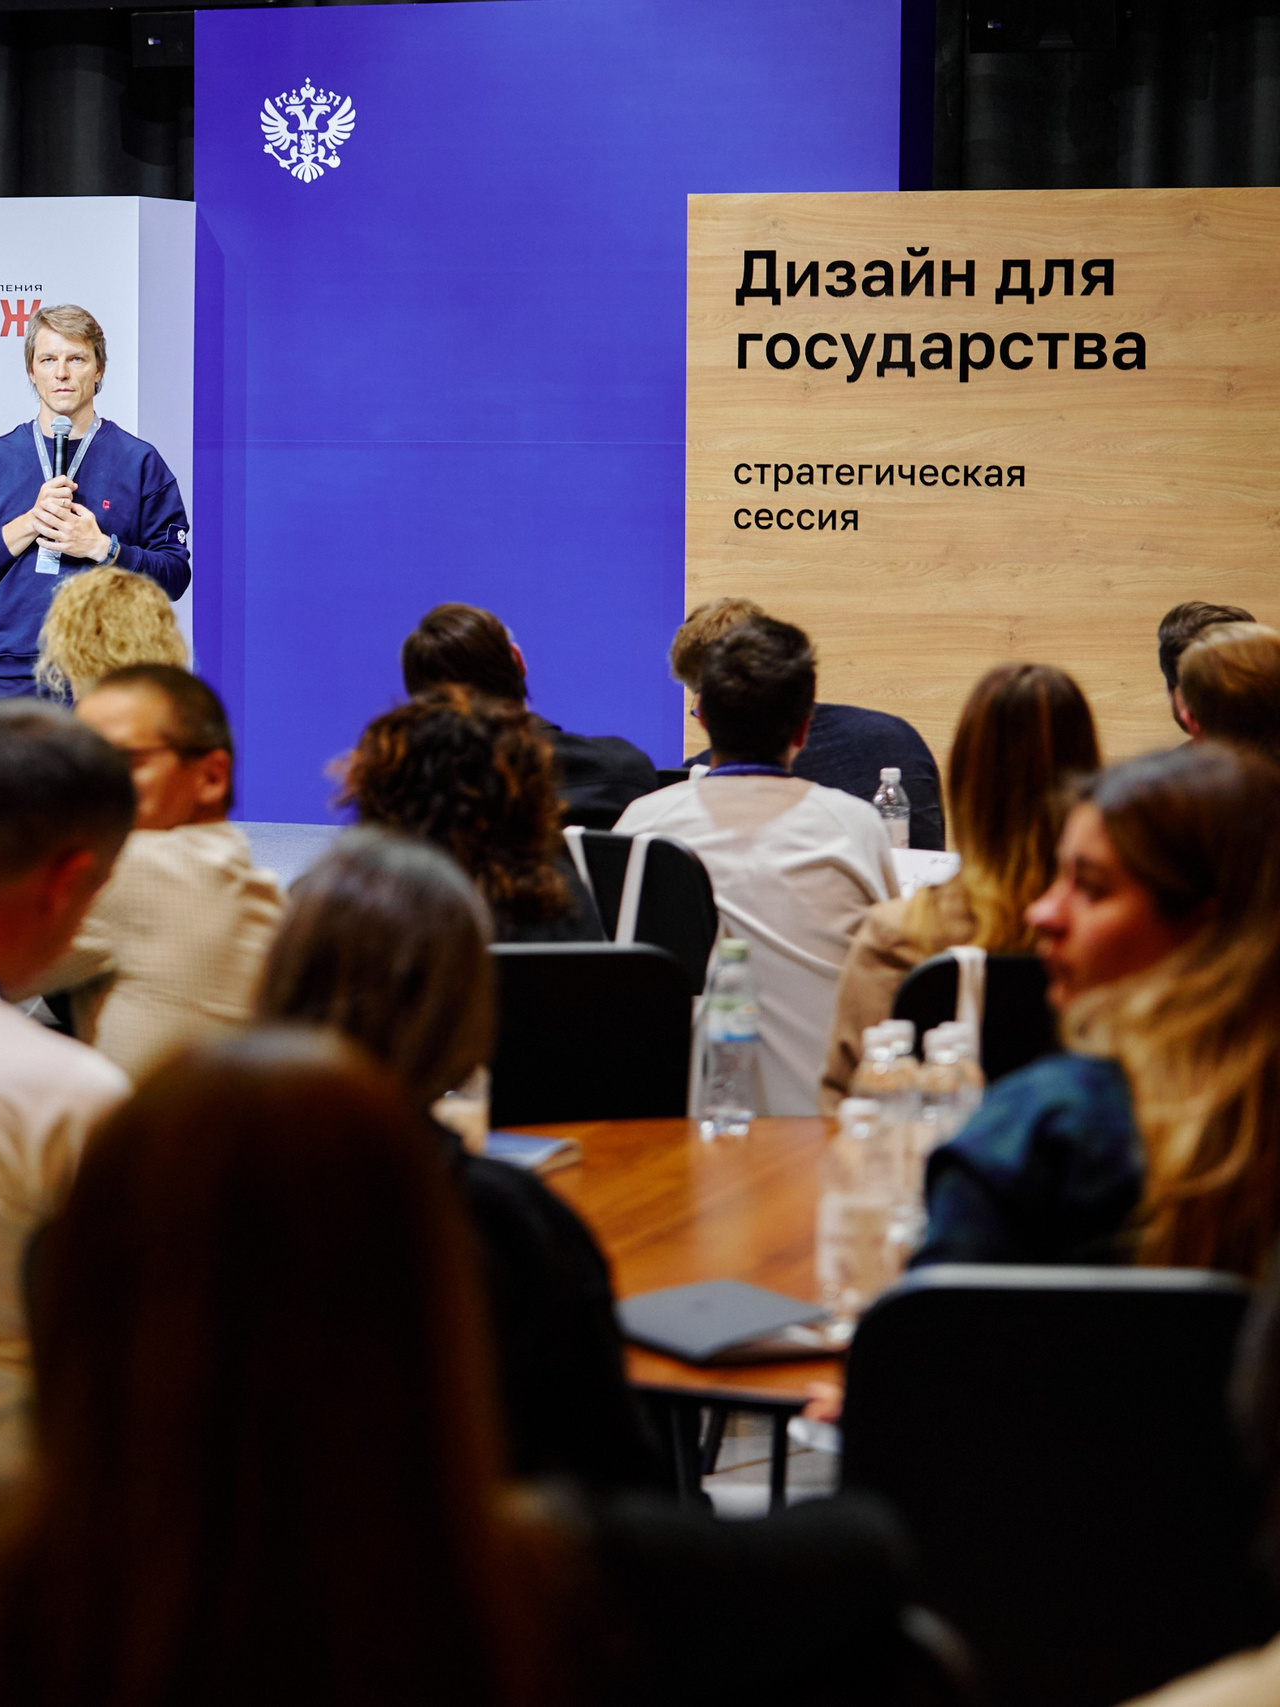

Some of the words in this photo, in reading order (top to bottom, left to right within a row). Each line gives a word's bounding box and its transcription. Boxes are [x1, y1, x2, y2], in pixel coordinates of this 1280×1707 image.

[735, 246, 976, 306] Дизайн
[995, 257, 1115, 304] для
[737, 330, 1147, 383] государства
[733, 461, 1026, 491] стратегическая
[733, 507, 859, 531] сессия
